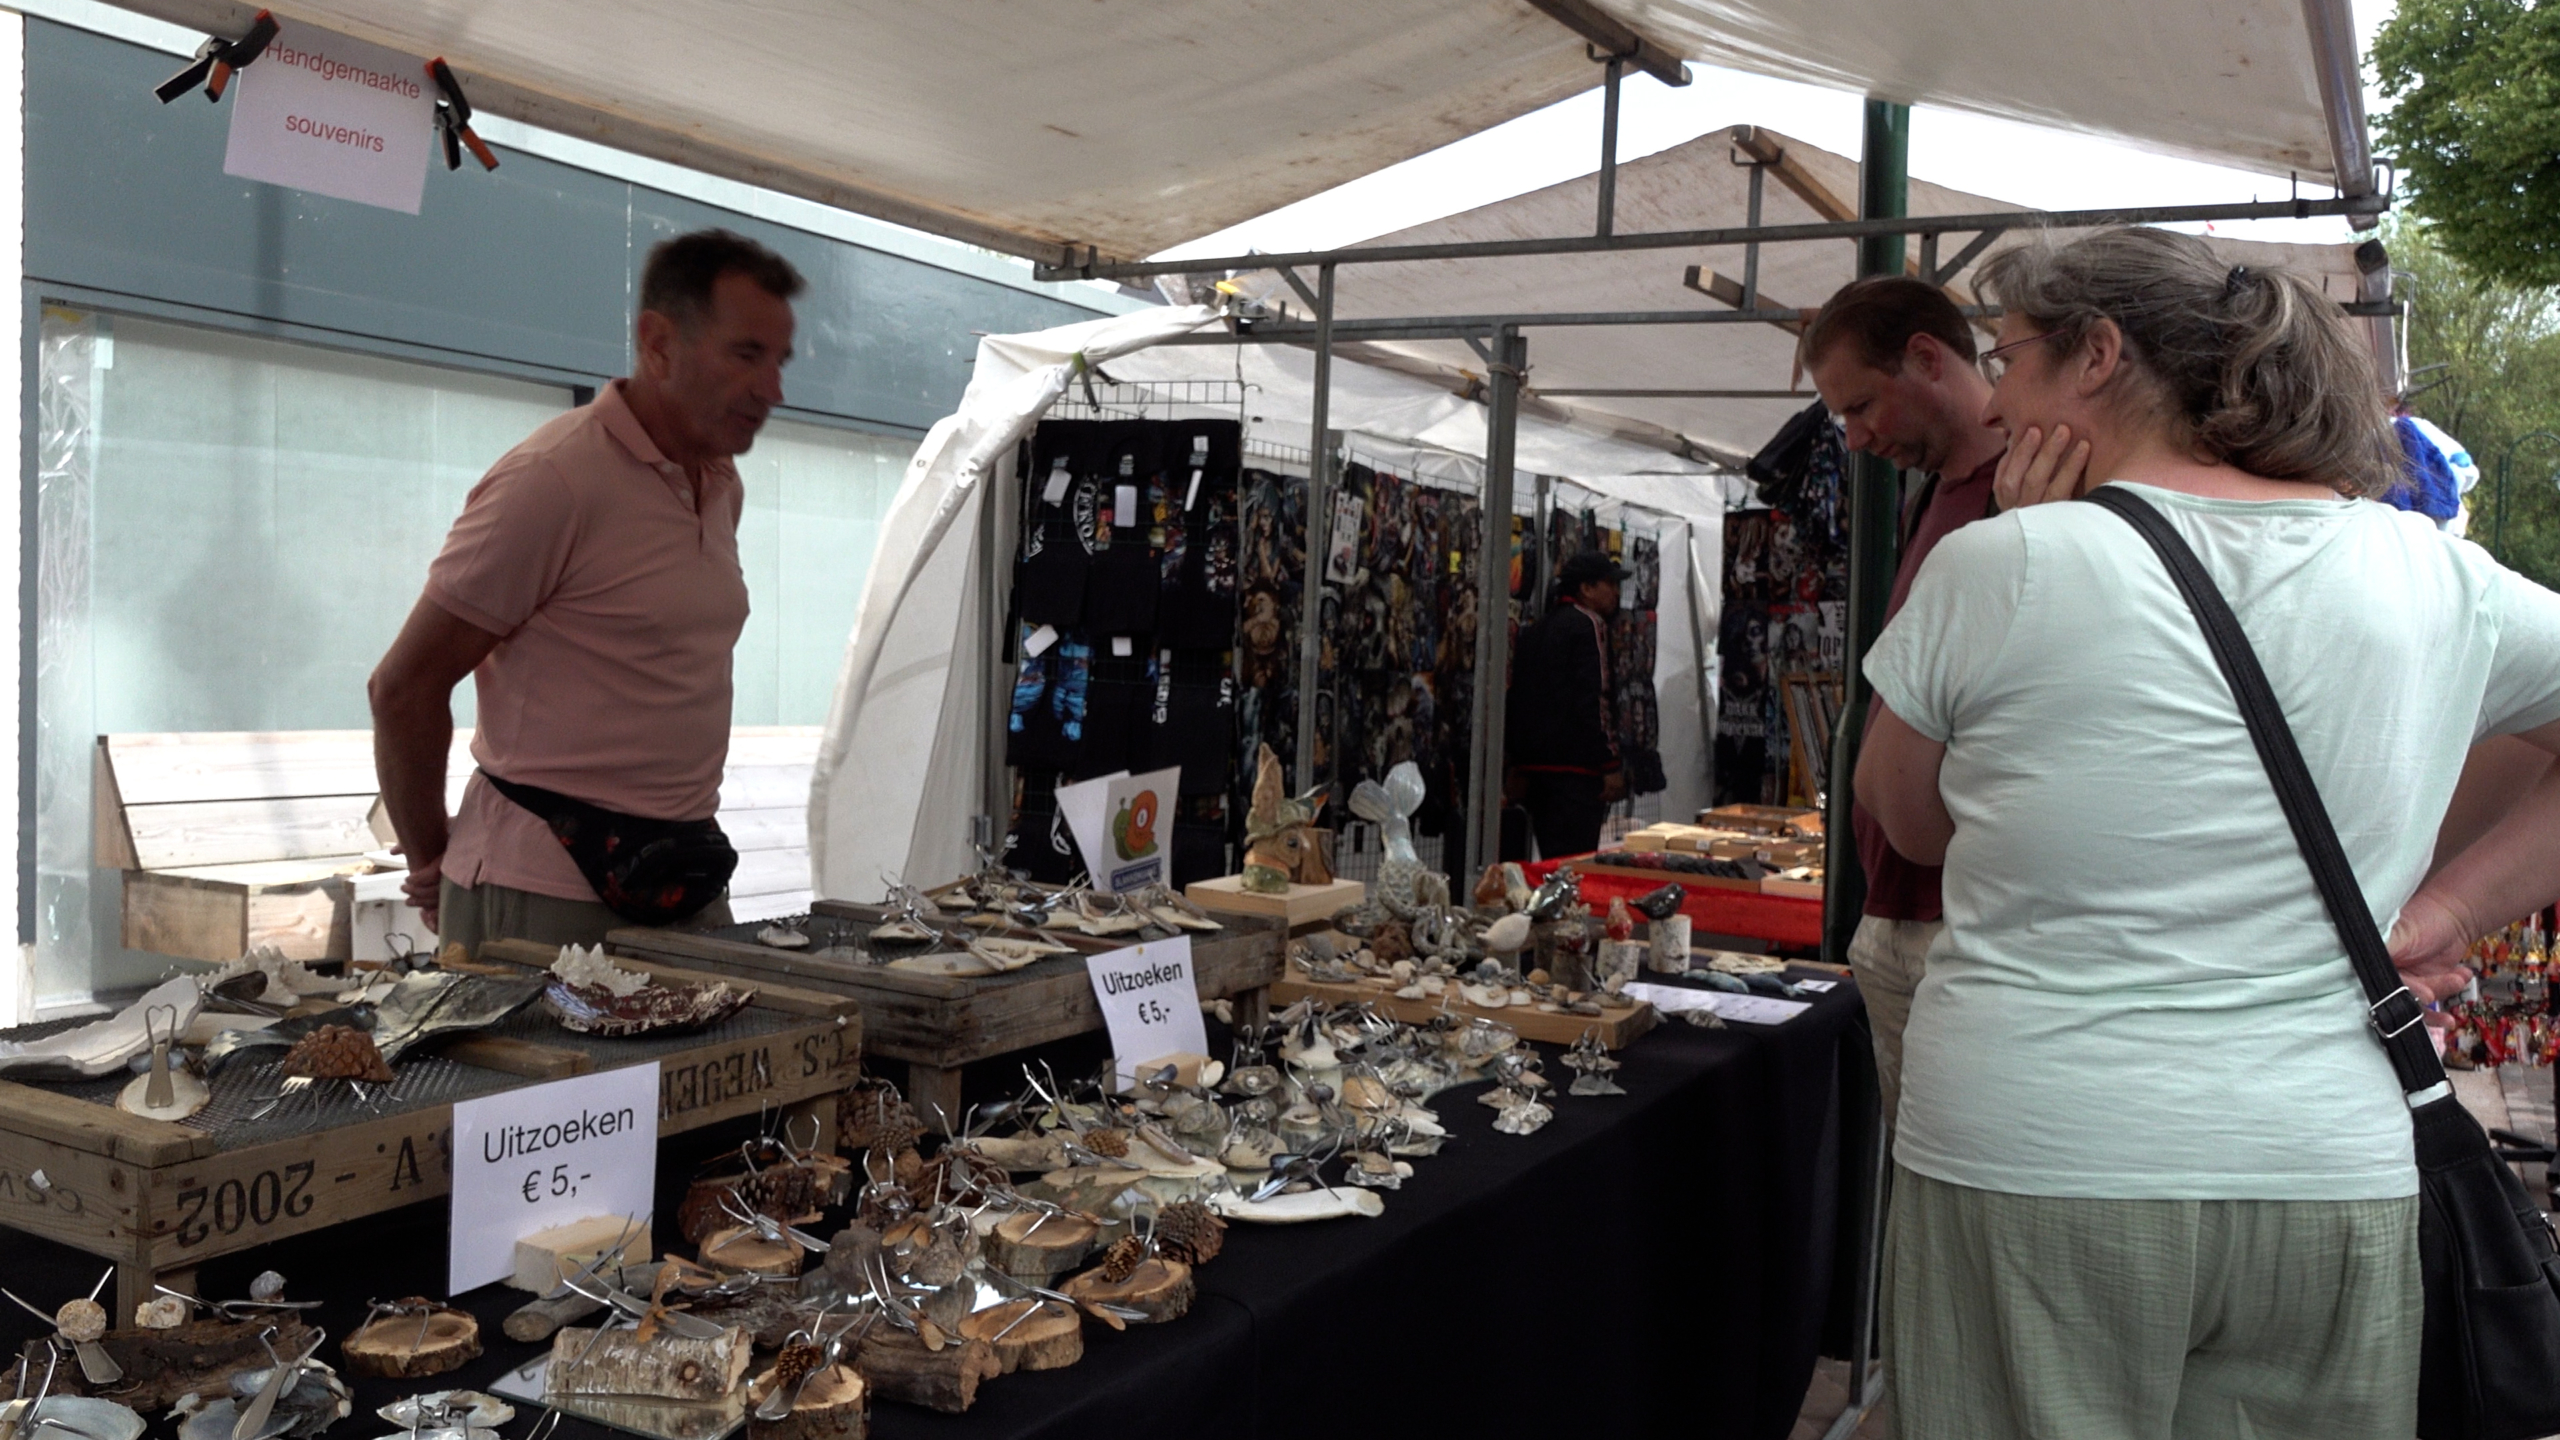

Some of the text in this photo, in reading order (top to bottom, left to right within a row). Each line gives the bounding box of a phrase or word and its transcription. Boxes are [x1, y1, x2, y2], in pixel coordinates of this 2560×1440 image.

[265, 41, 421, 99] Handgemaakte
[286, 114, 384, 153] souvenirs
[1102, 962, 1184, 996] Uitzoeken
[1138, 1000, 1171, 1025] € 5,-
[484, 1107, 634, 1163] Uitzoeken
[522, 1164, 592, 1203] € 5,-
[176, 1159, 315, 1249] 2002
